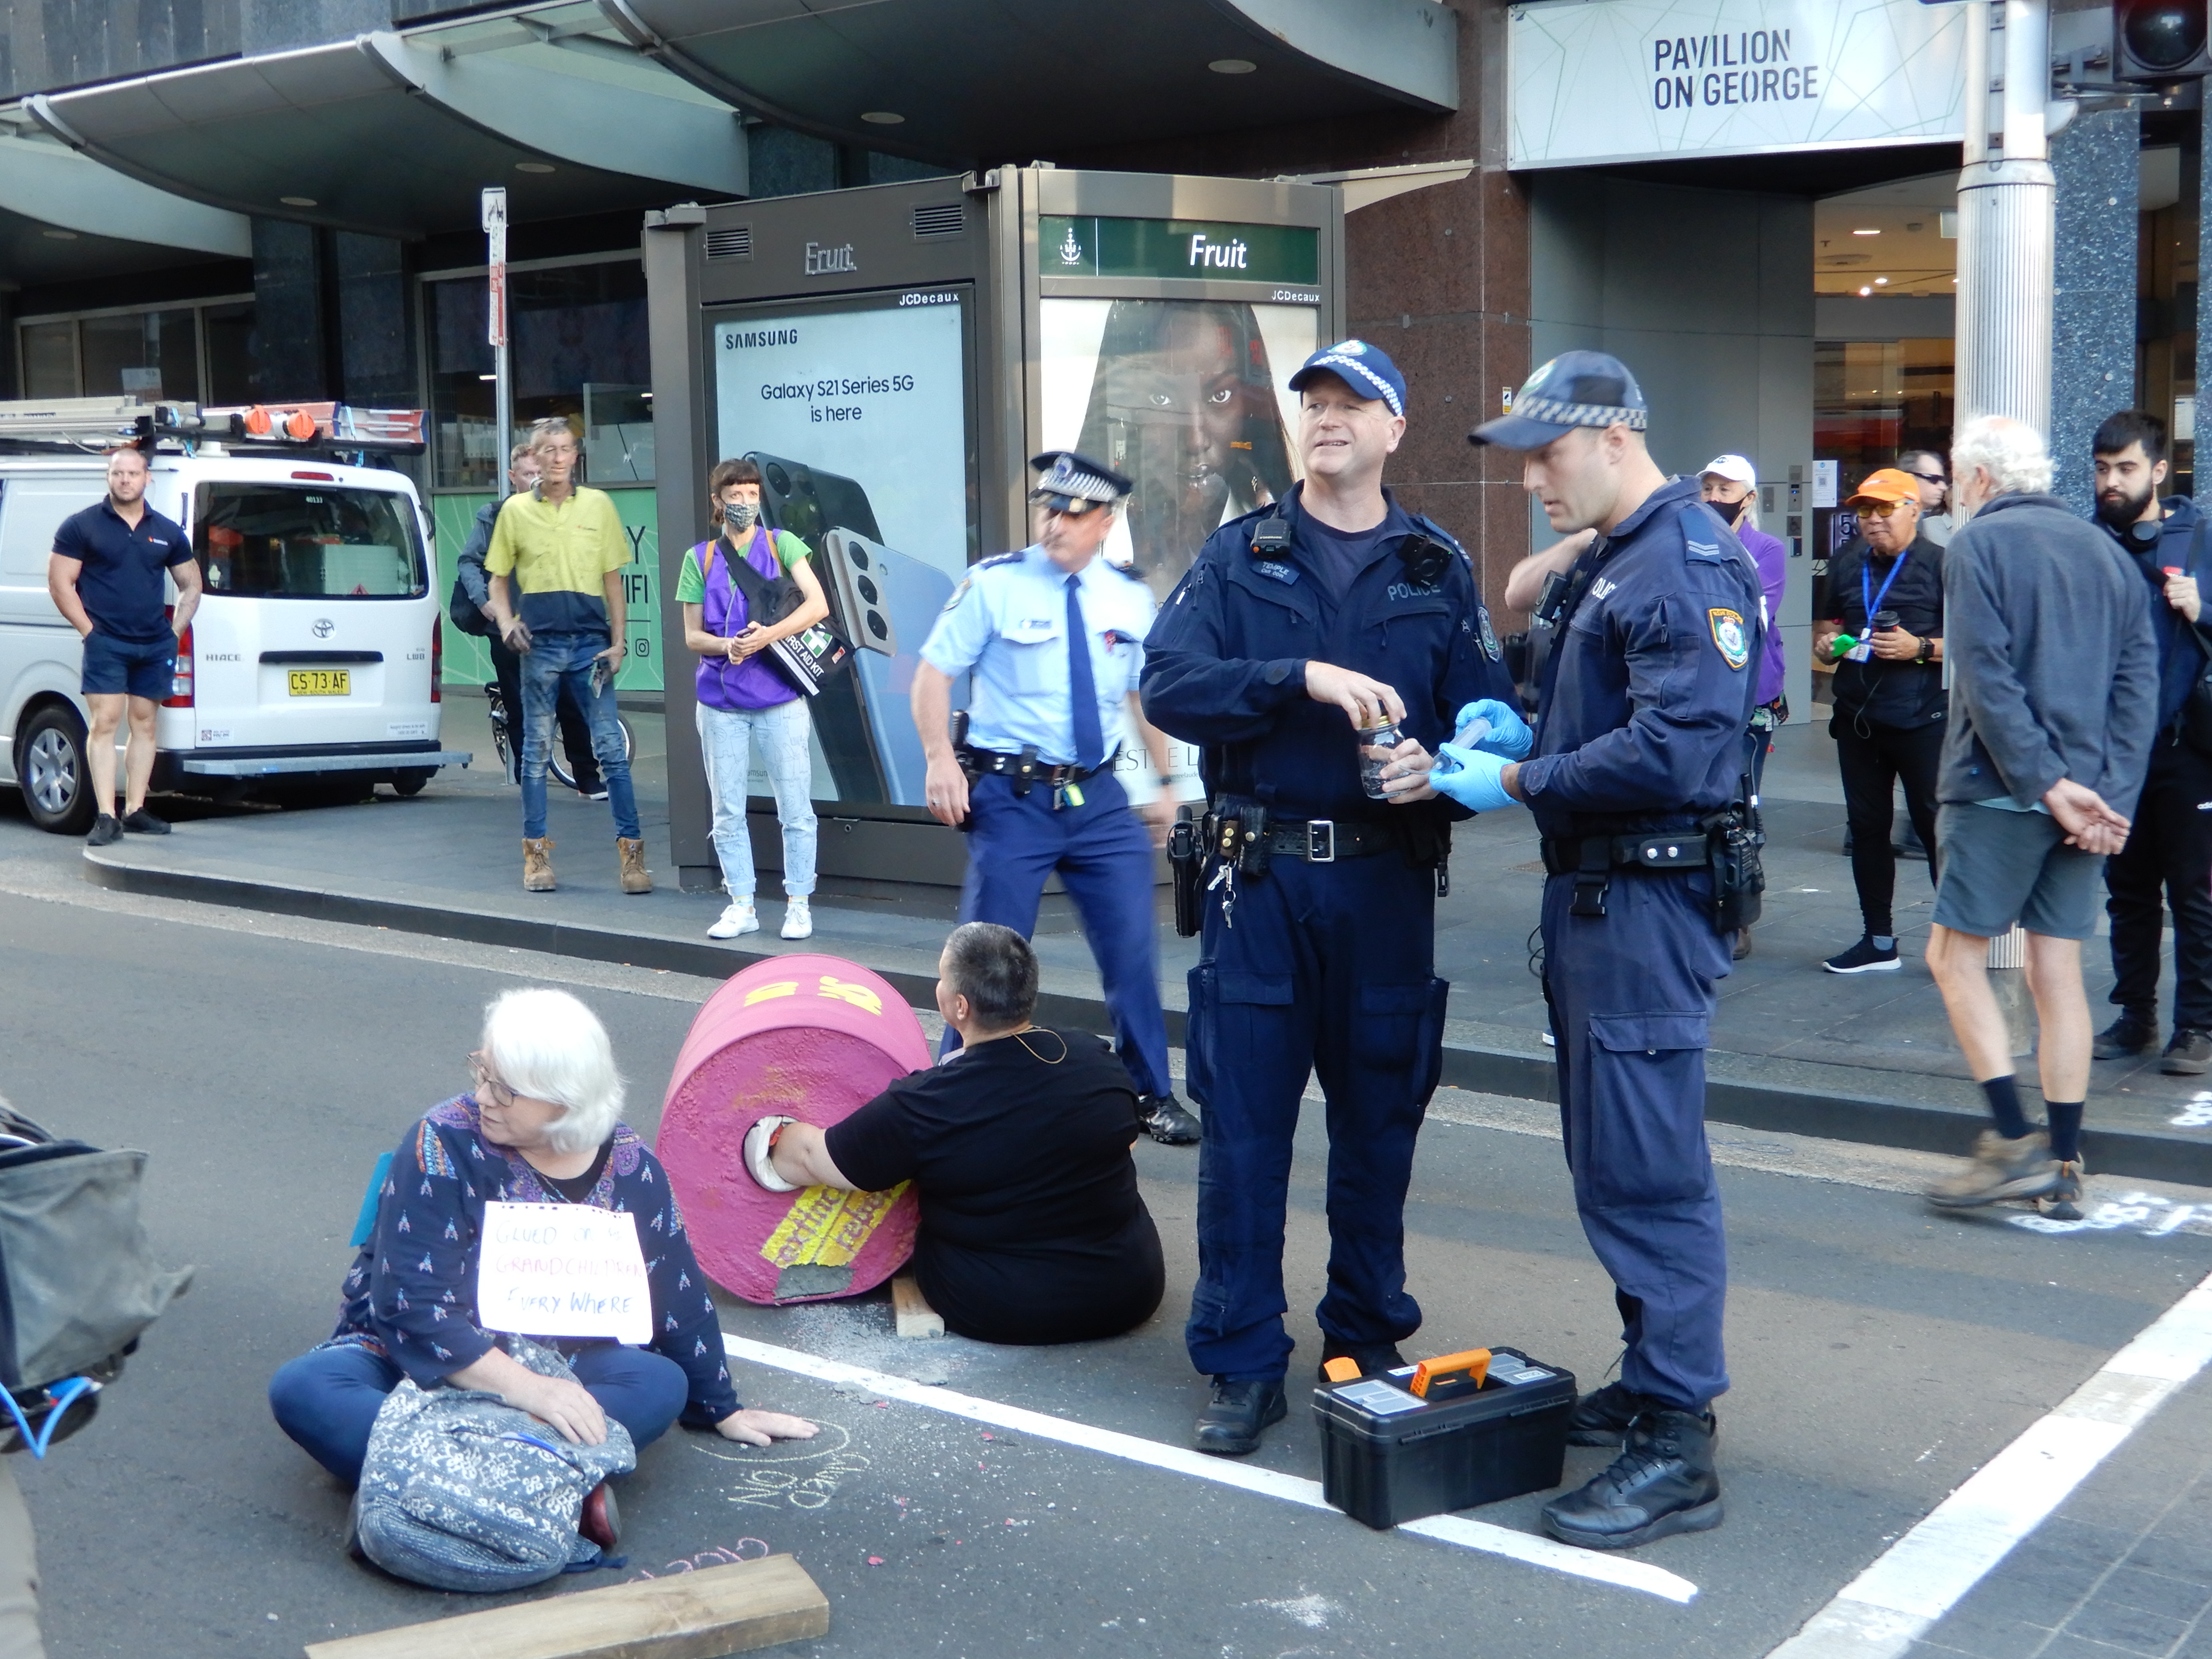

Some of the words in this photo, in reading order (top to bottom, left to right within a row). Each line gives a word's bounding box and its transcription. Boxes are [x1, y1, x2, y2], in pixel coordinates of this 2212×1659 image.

[1655, 29, 1790, 72] PAVILION
[1655, 76, 1693, 110] ON
[1703, 66, 1818, 106] GEORGE
[805, 242, 856, 276] Fruit
[1190, 235, 1247, 268] Fruit
[899, 293, 959, 306] JCDecaux
[1272, 290, 1320, 302] JCDecaux
[726, 329, 798, 350] SAMSUNG
[761, 383, 814, 402] Galaxy
[817, 380, 838, 396] S21
[842, 376, 890, 394] Series
[893, 375, 914, 391] 5G
[811, 405, 822, 422] is
[826, 405, 862, 422] here
[626, 526, 646, 565] Y
[621, 574, 648, 604] IFI
[799, 651, 814, 666] AID
[810, 661, 824, 677] KIT
